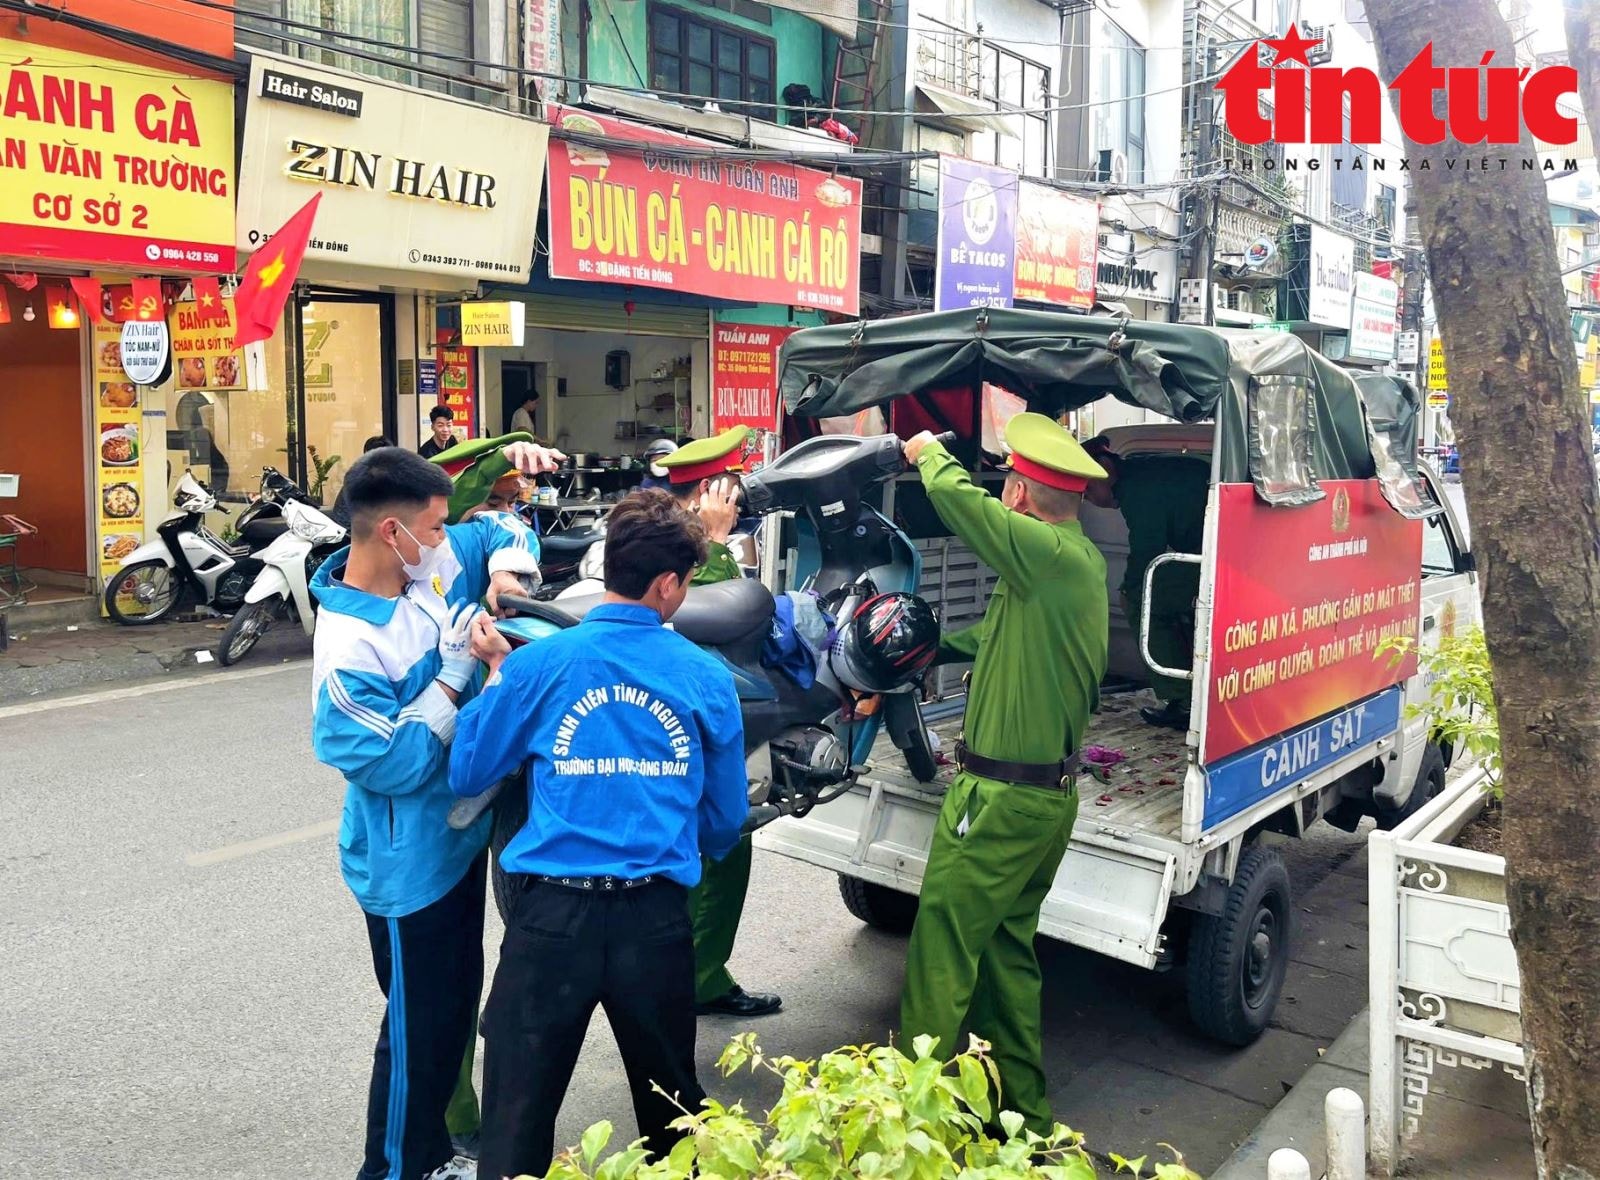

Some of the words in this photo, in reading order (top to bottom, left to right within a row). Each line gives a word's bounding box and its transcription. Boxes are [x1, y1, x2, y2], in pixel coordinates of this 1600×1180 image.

[0, 56, 114, 133] ÁNH
[134, 84, 201, 148] GÀ
[267, 75, 307, 100] Hair
[310, 85, 358, 112] Salon
[0, 137, 26, 170] N
[39, 138, 102, 180] VĂN
[114, 154, 227, 198] TRƯỜNG
[285, 138, 382, 190] ZIN
[391, 158, 497, 209] HAIR
[725, 160, 764, 194] TUẤN
[768, 174, 799, 201] ANH
[32, 192, 73, 221] CƠ
[83, 192, 121, 226] SỞ
[132, 204, 149, 230] 2
[569, 165, 640, 258] BÚN
[704, 203, 777, 280] CANH
[783, 210, 814, 286] CÁ
[820, 218, 848, 290] RÔ
[308, 236, 324, 249] IẾN
[422, 254, 442, 264] 0343
[459, 258, 470, 267] 711
[950, 240, 967, 264] BÊ
[968, 252, 1006, 268] TACOS
[126, 324, 140, 336] ZIN
[142, 324, 160, 336] Hair
[224, 336, 234, 349] TH
[464, 324, 481, 335] ZIN
[484, 324, 510, 335] HAIR
[718, 326, 746, 344] TUẤN
[747, 334, 770, 345] ANH
[760, 382, 770, 416] CÁ
[1224, 618, 1257, 652] CÔNG
[1261, 622, 1277, 644] AN
[1302, 596, 1340, 632] PHƯỜNG
[1342, 588, 1360, 621] GẮN
[1363, 588, 1375, 616] BÓ
[1377, 584, 1396, 611] MẬT
[1398, 576, 1416, 604] THIẾT
[1218, 666, 1240, 702] VỚI
[1243, 657, 1276, 694] CHÍNH
[1318, 634, 1345, 668] ĐOÀN
[1348, 622, 1364, 654] THỂ
[1365, 624, 1377, 650] VÀ
[552, 714, 580, 756] SINH
[572, 686, 608, 717] VIÊN
[612, 682, 650, 708] TÌNH
[648, 700, 690, 758] NGUYỆN
[554, 756, 595, 776] TRƯỜNG
[598, 758, 615, 777] ĐẠI
[662, 759, 688, 776] ĐOÀN
